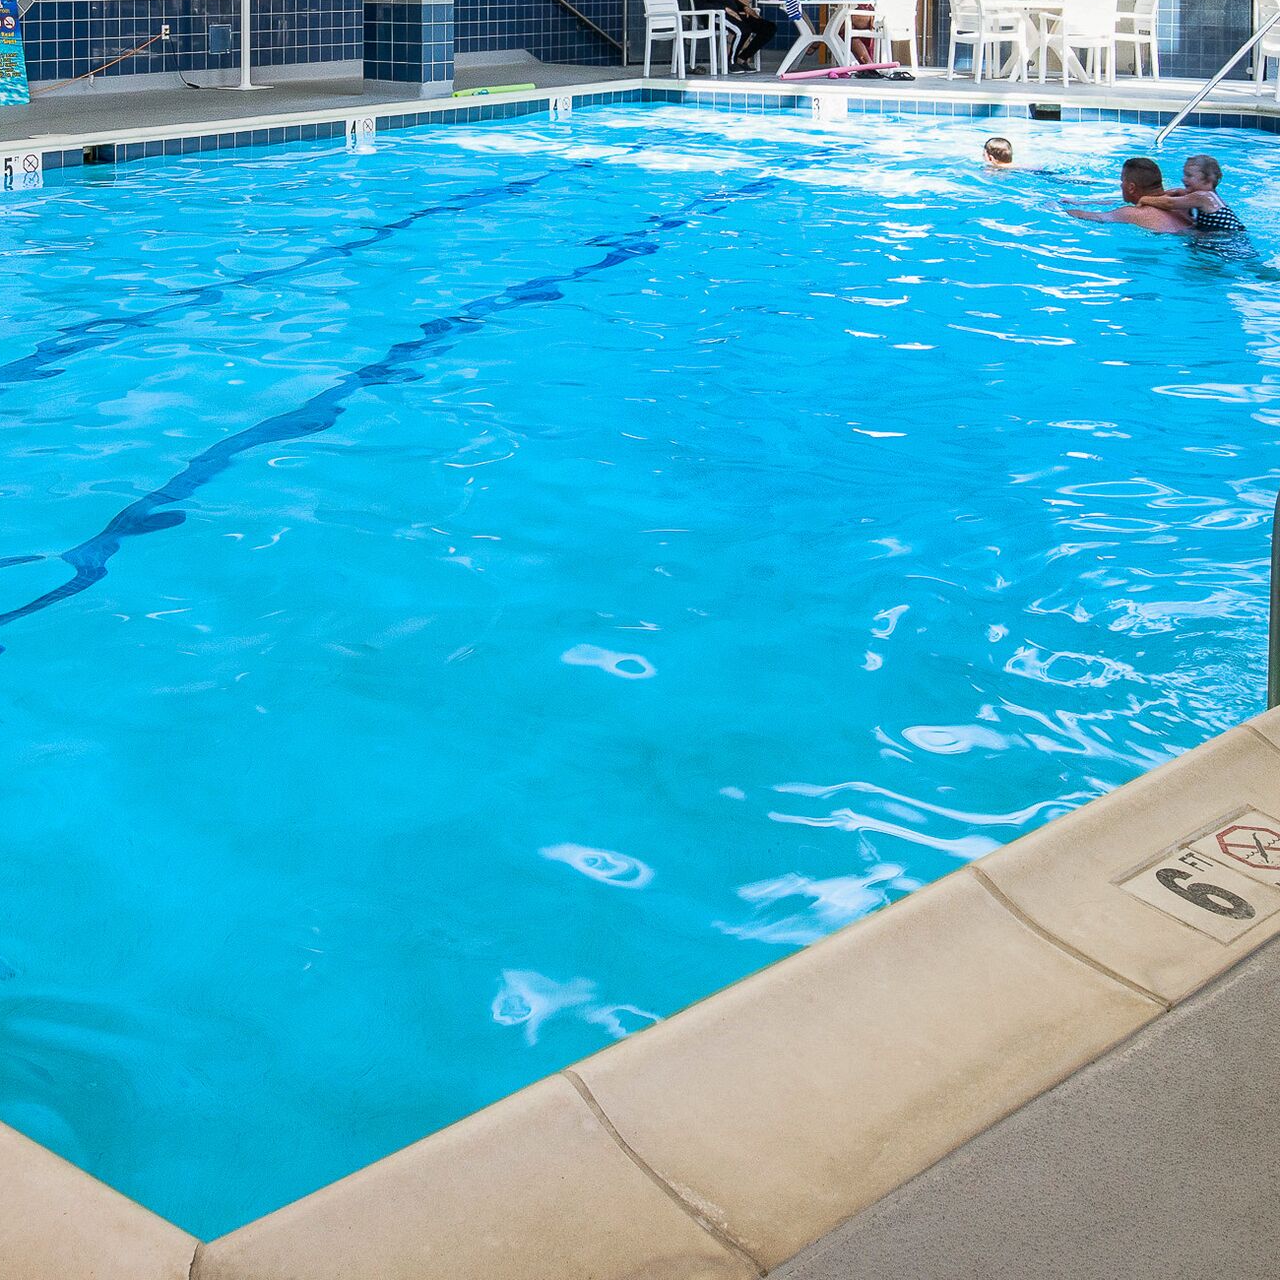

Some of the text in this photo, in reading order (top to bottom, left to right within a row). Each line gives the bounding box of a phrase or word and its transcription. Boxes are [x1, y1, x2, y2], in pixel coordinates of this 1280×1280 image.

[814, 98, 820, 111] 3
[4, 157, 13, 176] 5
[1156, 852, 1256, 920] 6 FT
